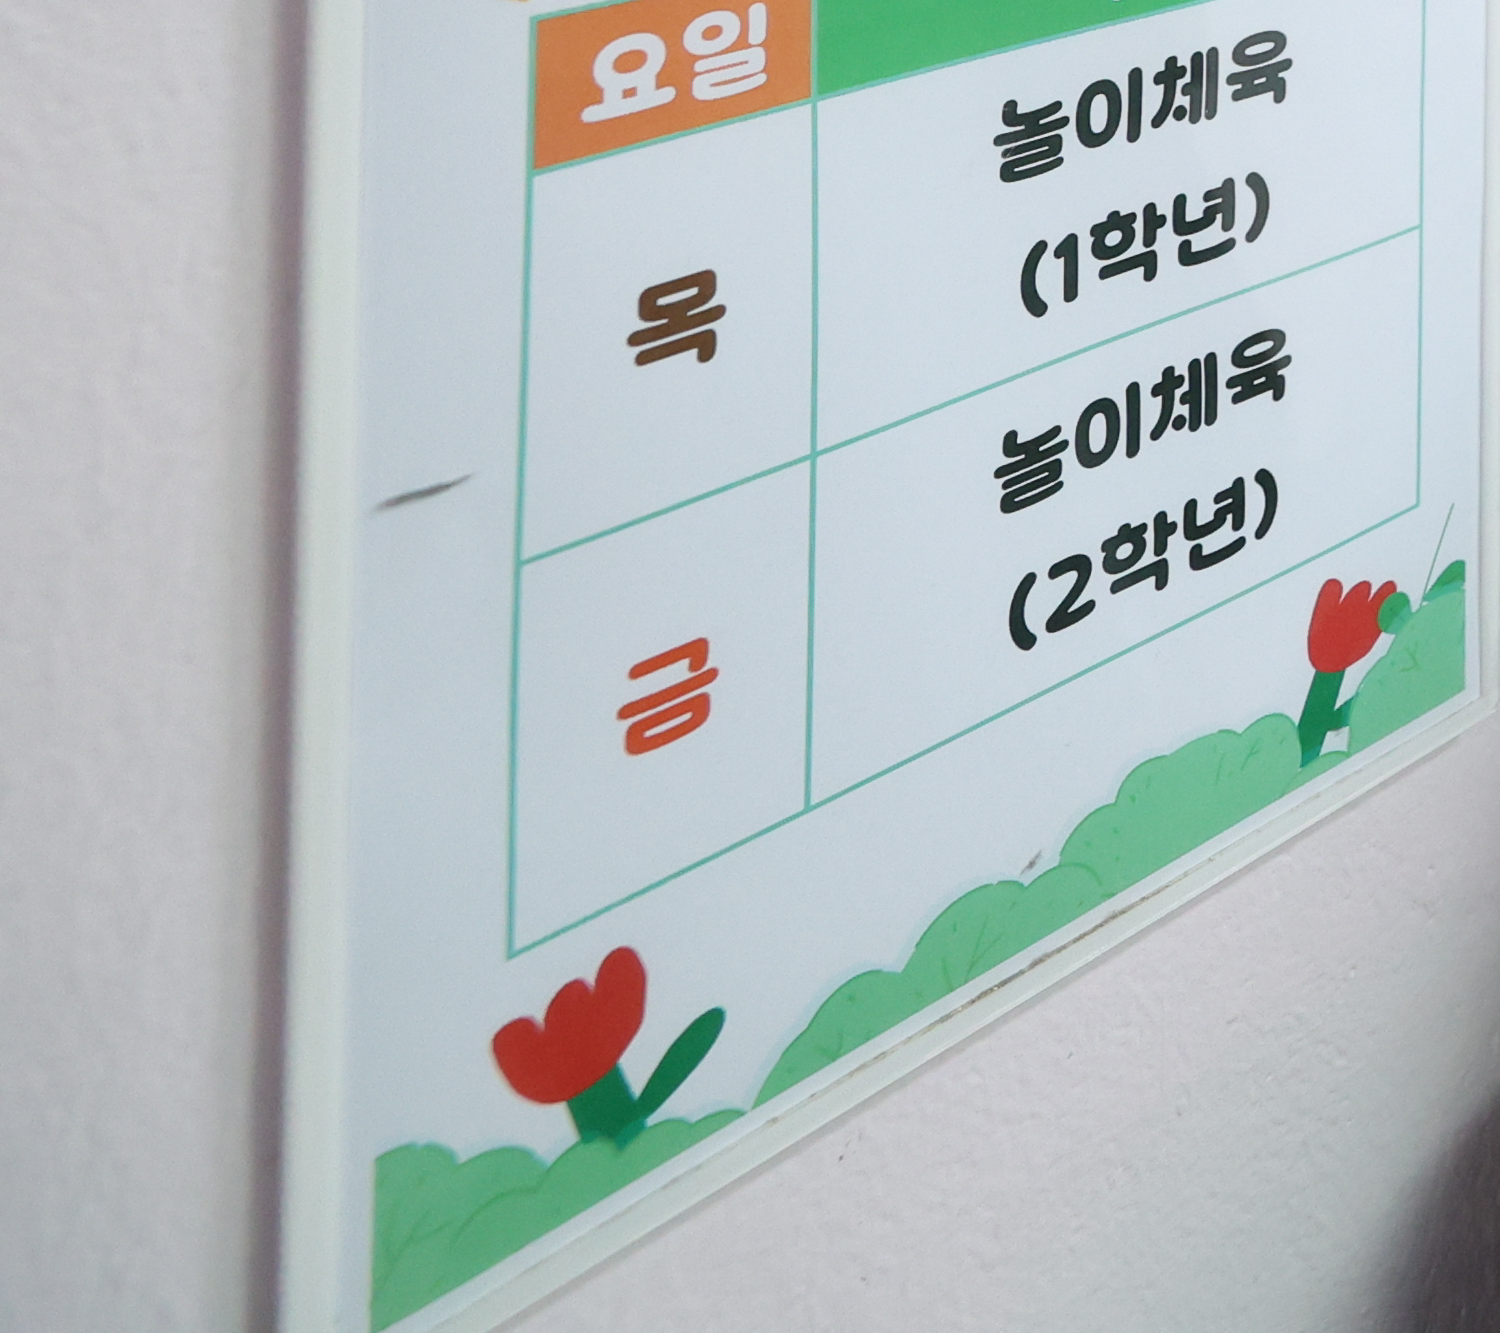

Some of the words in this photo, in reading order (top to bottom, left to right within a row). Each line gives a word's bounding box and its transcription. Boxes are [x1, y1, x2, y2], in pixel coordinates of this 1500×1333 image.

[580, 2, 769, 123] 요일
[993, 30, 1293, 183] 놀이체육
[626, 269, 725, 367] 목
[1020, 173, 1270, 318] (1학년)
[993, 328, 1292, 514] 놀이체육
[1008, 468, 1278, 651] (2학년)
[616, 636, 719, 757] 금
